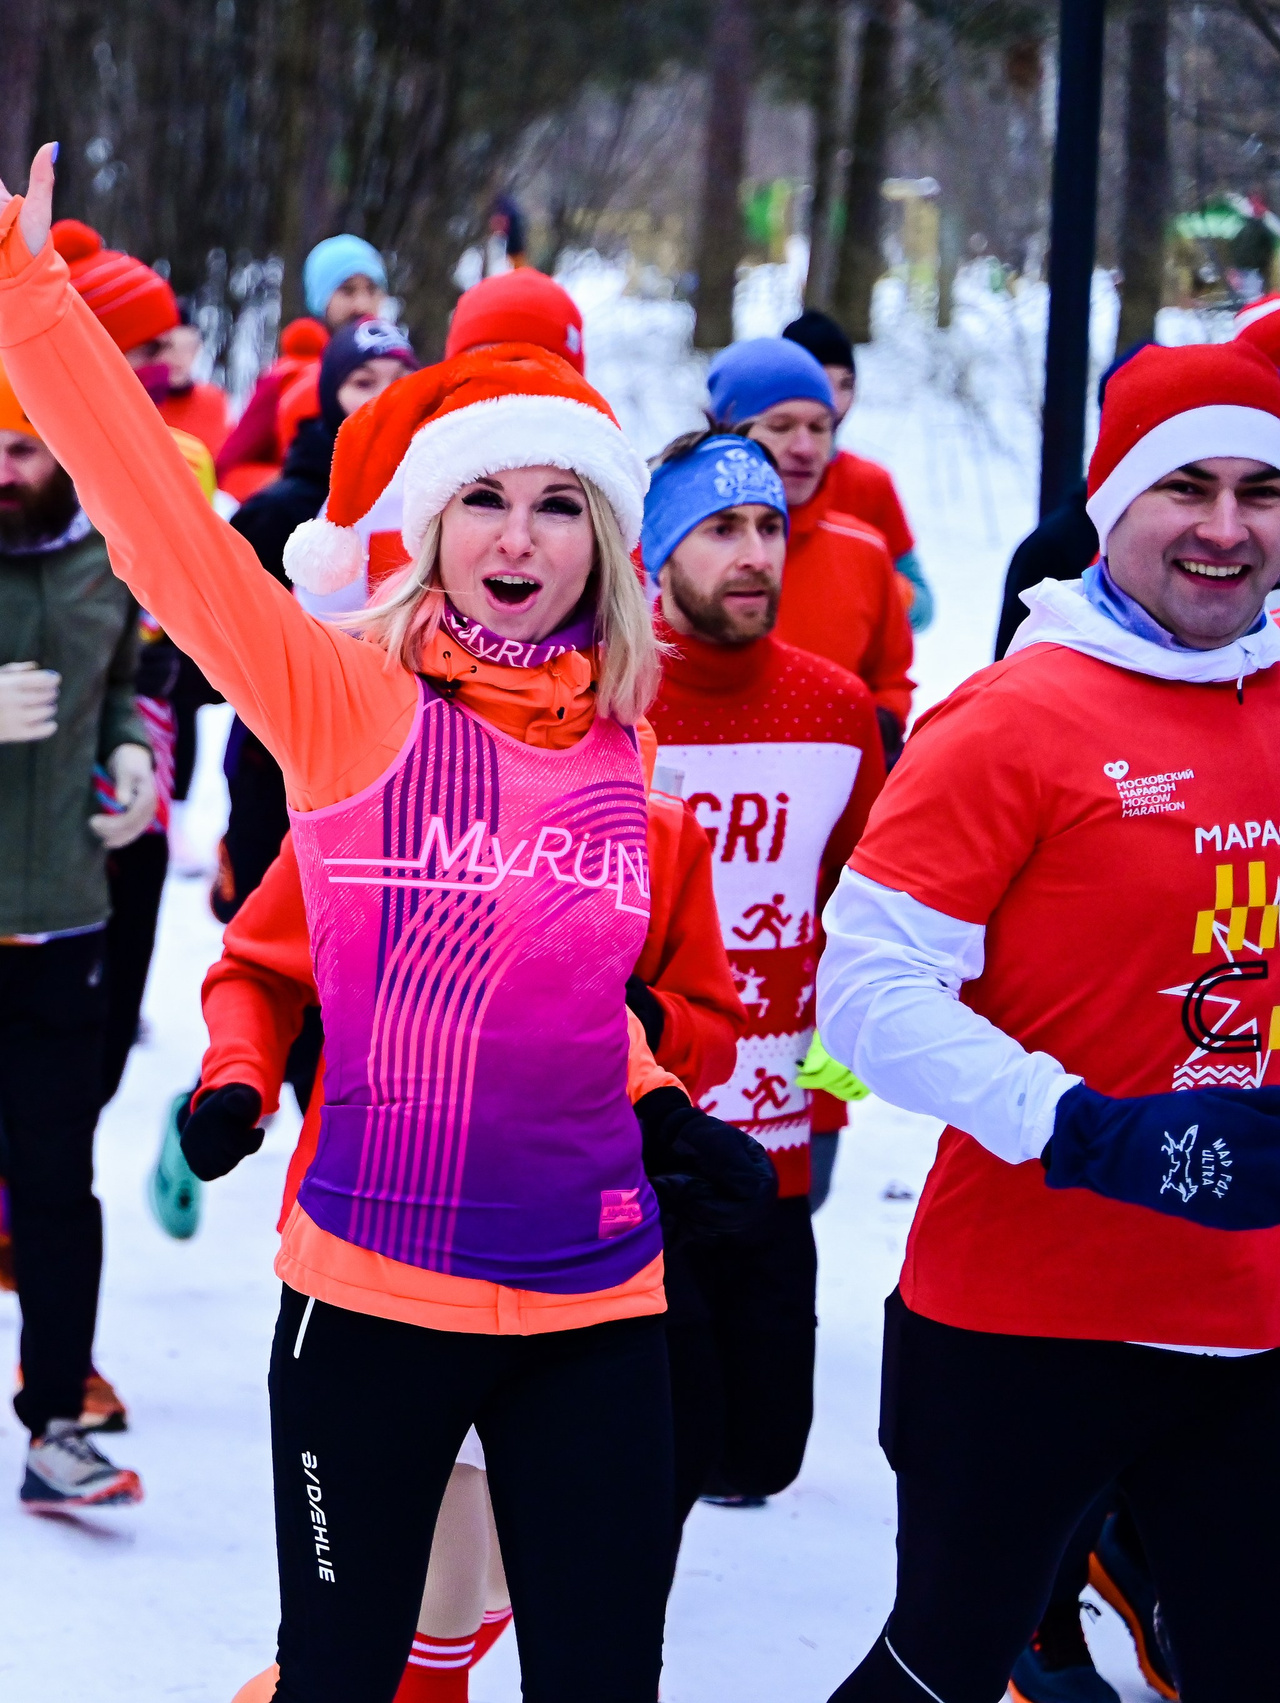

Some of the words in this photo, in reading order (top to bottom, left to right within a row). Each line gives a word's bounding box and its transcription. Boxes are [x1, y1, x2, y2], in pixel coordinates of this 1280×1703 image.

[1116, 768, 1195, 790] МОСКОВСКИЙ
[1119, 782, 1177, 799] МАРАФОН
[1122, 793, 1171, 809] MOSCOW
[1122, 801, 1186, 818] MARATHON
[1195, 819, 1280, 854] МАРА
[1212, 1138, 1233, 1167] MAD
[1201, 1149, 1215, 1186] ULTRA
[1212, 1173, 1233, 1198] FOX
